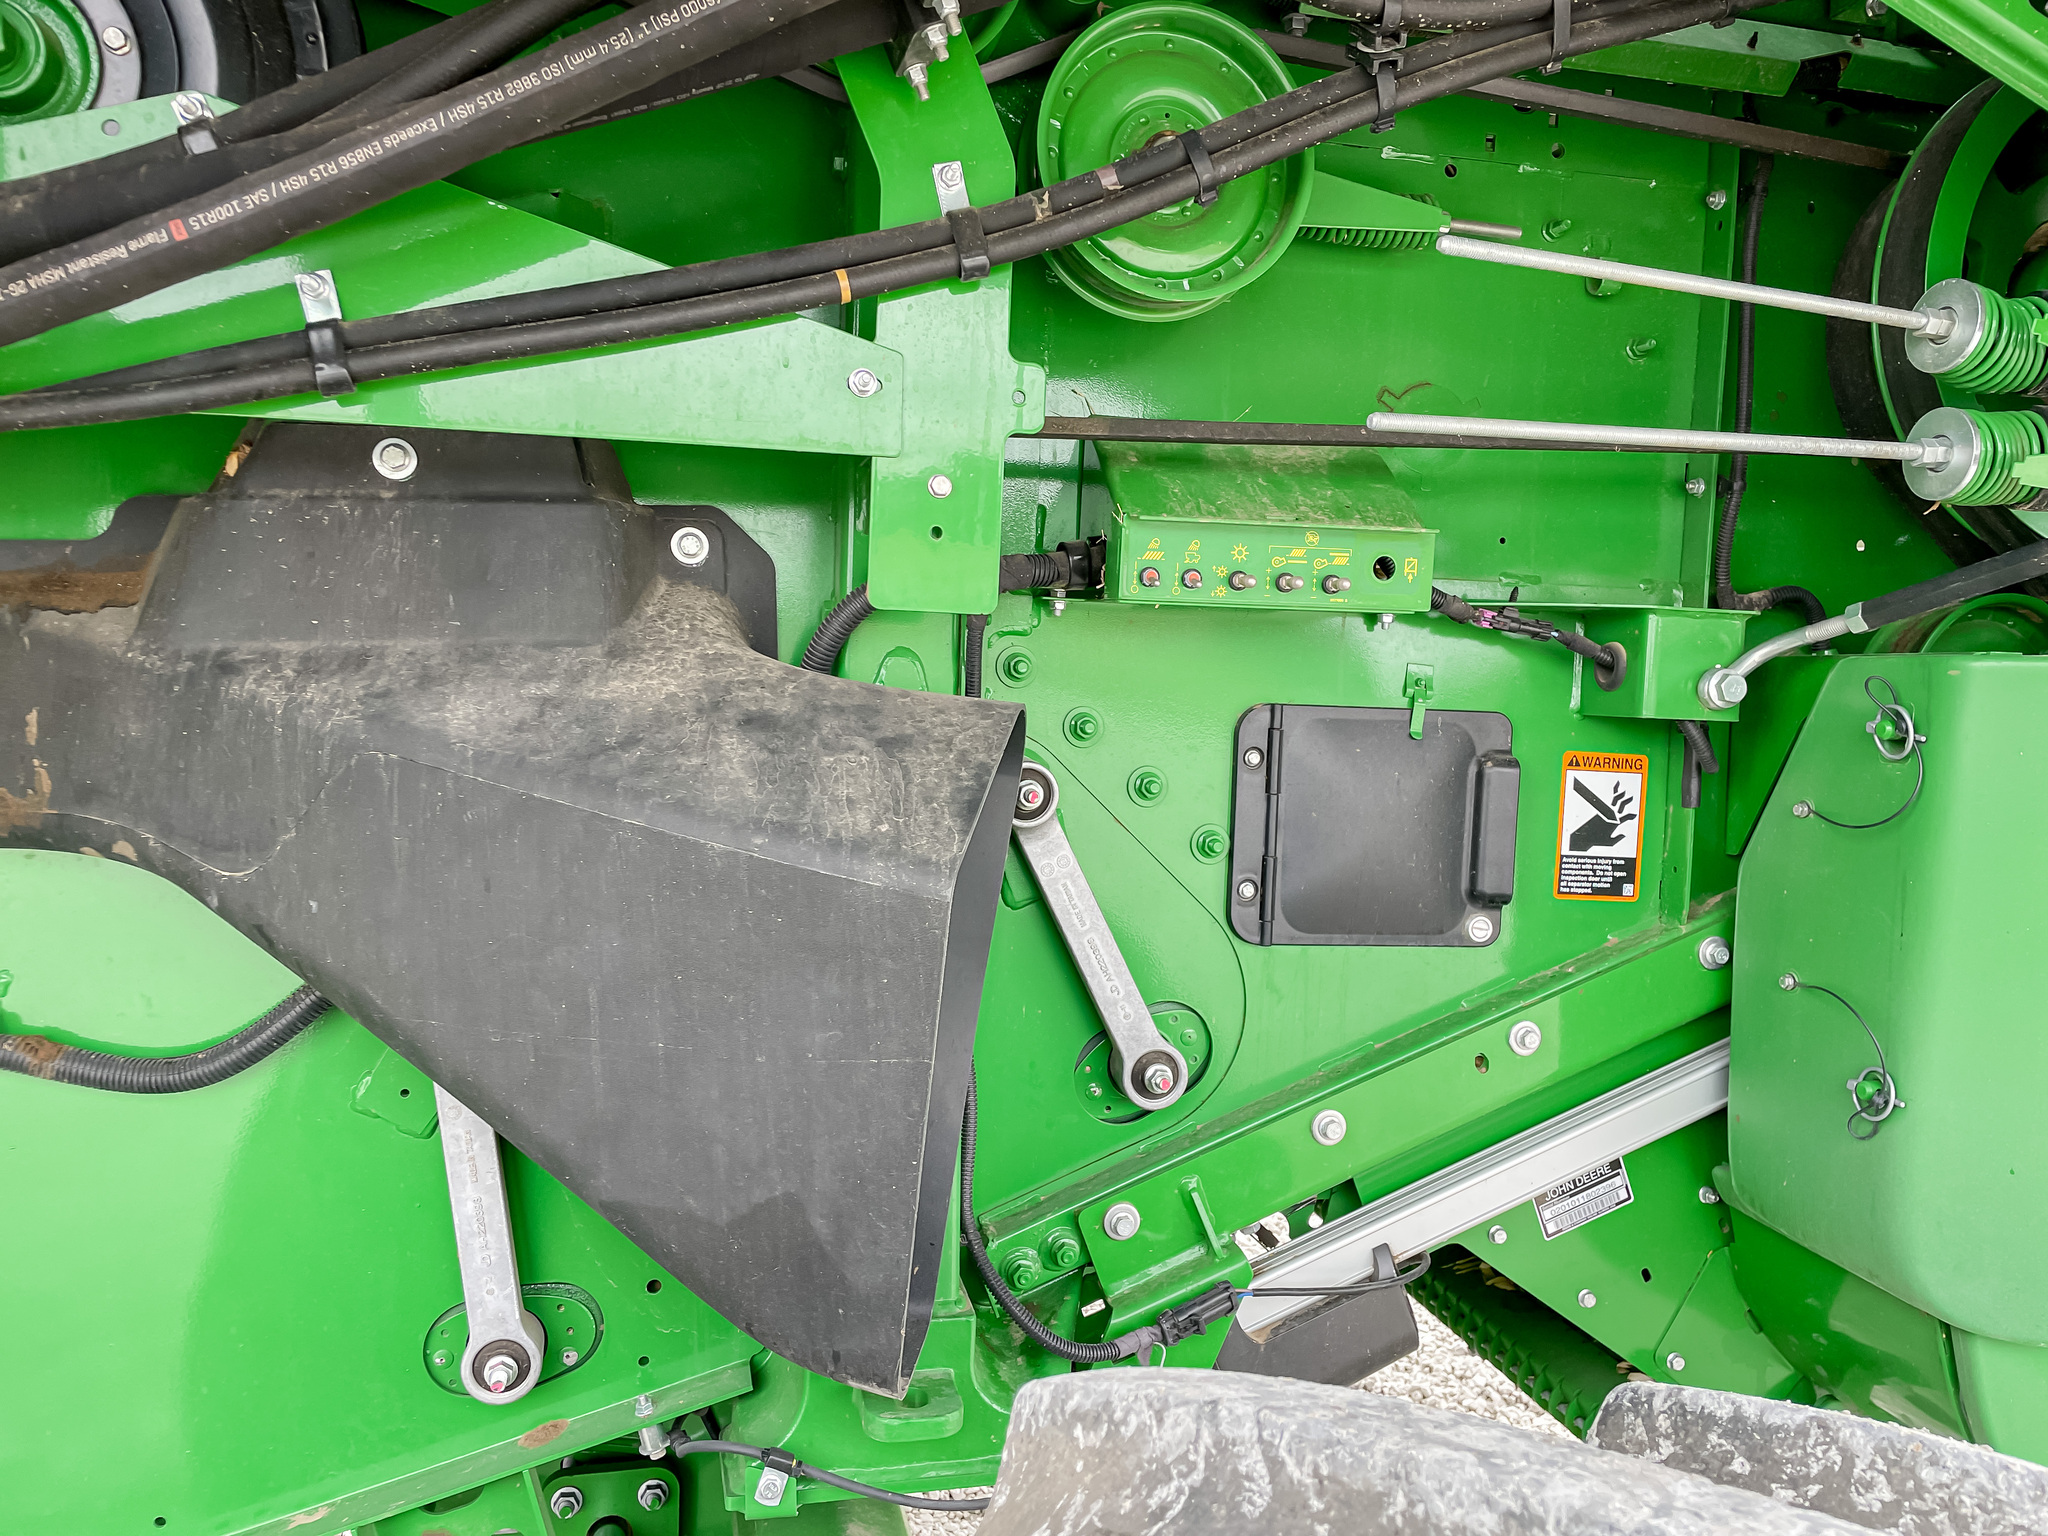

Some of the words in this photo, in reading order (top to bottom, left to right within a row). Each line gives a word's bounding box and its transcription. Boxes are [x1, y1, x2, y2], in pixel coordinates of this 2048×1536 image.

[600, 27, 635, 56] (25.4
[565, 44, 598, 71] mm)
[541, 60, 566, 82] ISO
[477, 86, 504, 111] R15
[449, 101, 476, 124] 4SH
[383, 117, 439, 149] Exceeds
[340, 140, 384, 171] EN856
[280, 174, 309, 194] 4SH
[309, 162, 339, 183] R15
[243, 188, 270, 210] SAE
[188, 199, 243, 231] 100R15
[128, 228, 170, 252] Flame
[66, 244, 130, 275] Resistant
[26, 265, 68, 290] MSHA
[1582, 755, 1643, 771] WARNING
[1545, 1181, 1575, 1202] JOHN
[1575, 1163, 1612, 1186] DEERE
